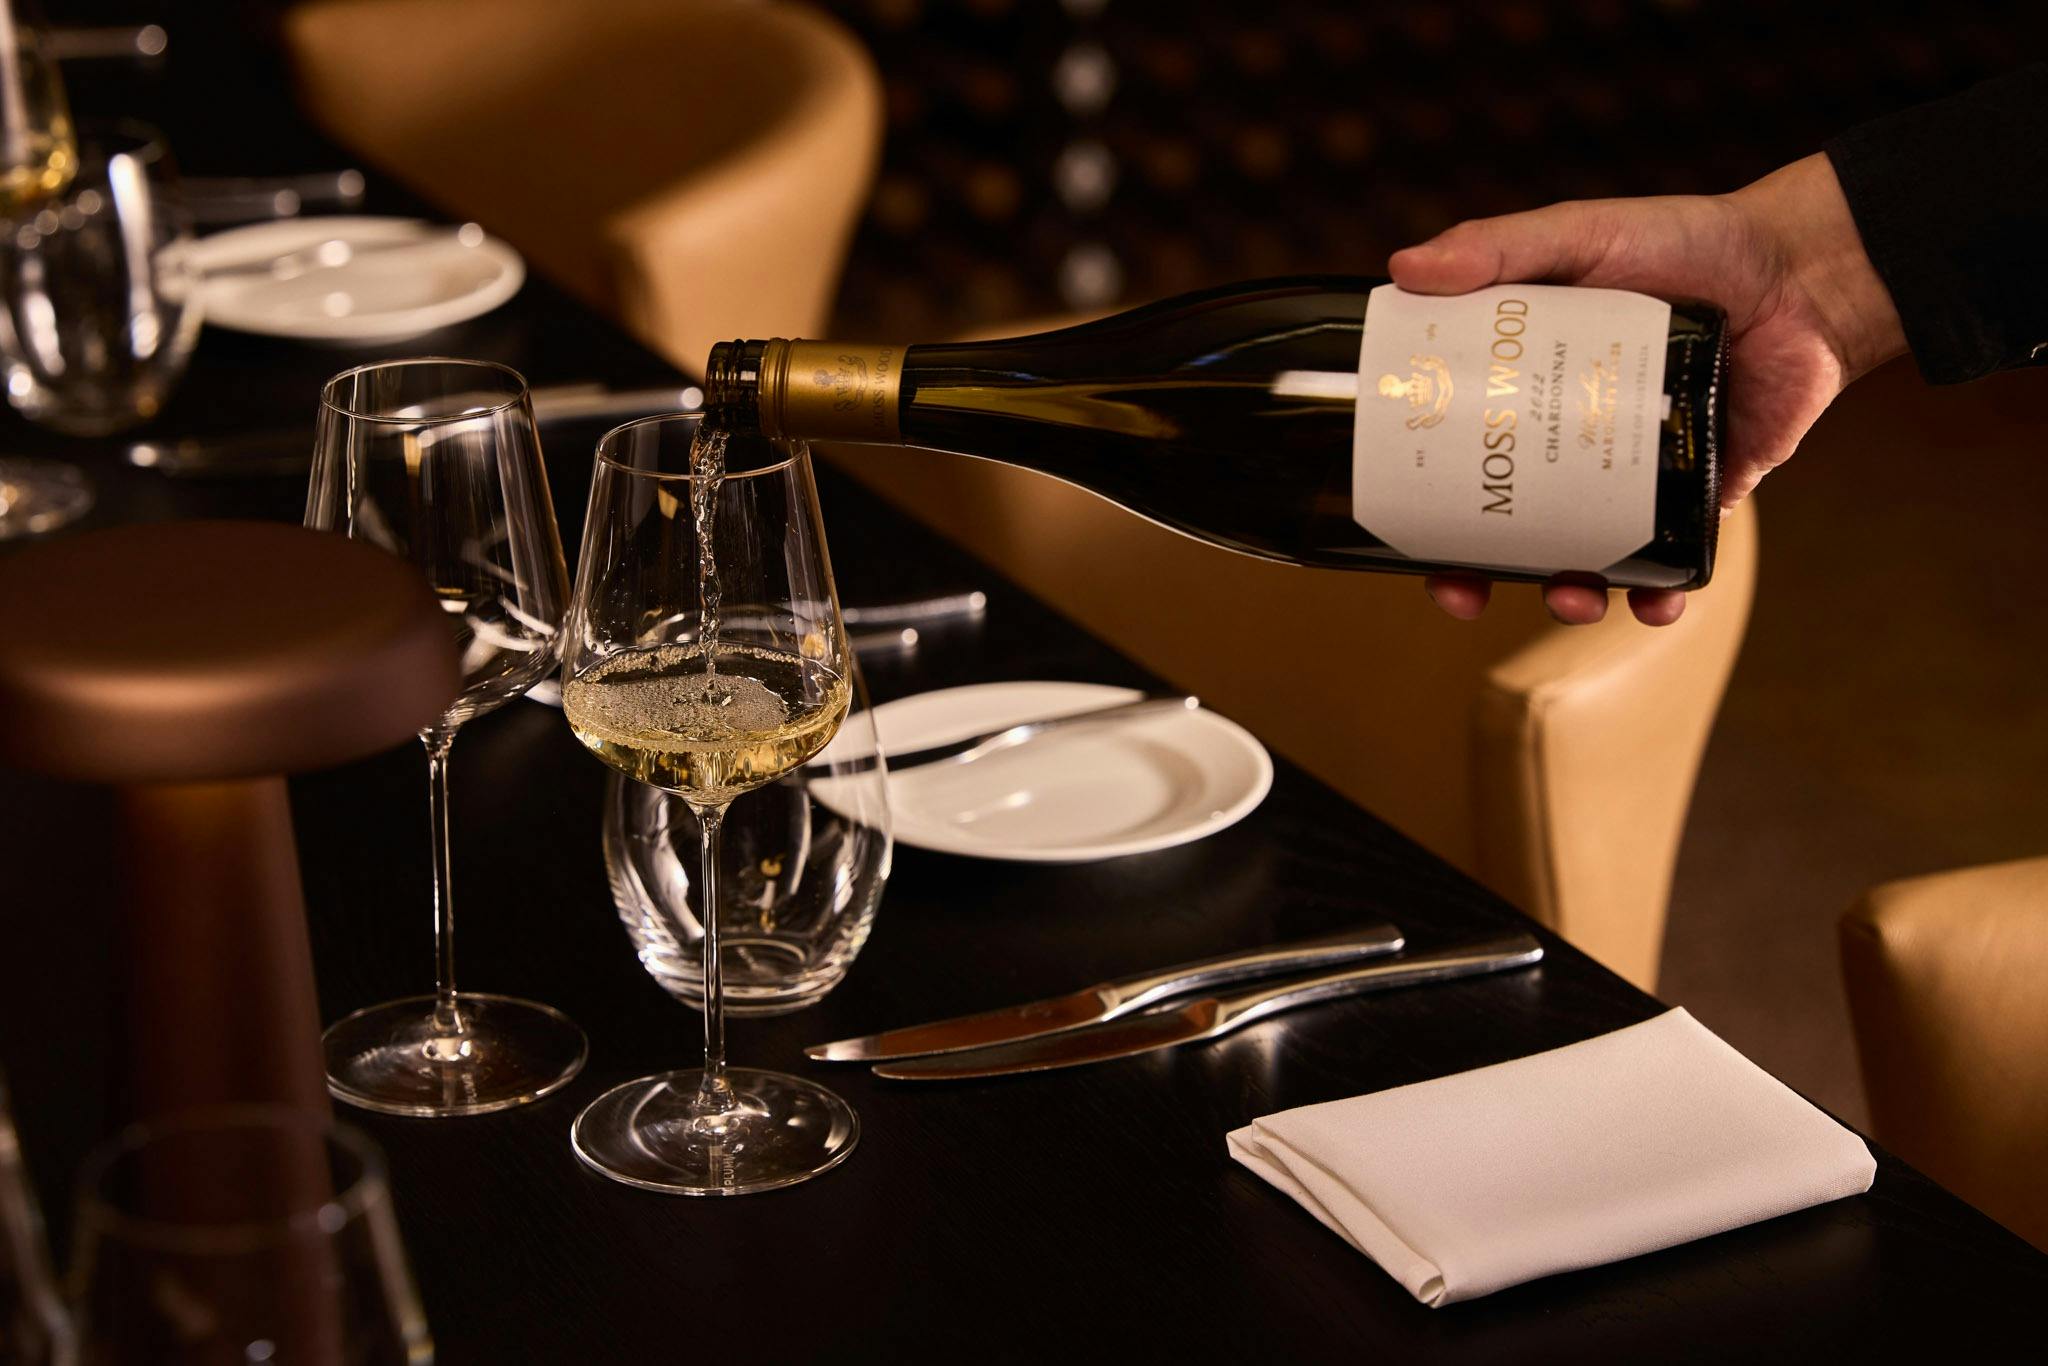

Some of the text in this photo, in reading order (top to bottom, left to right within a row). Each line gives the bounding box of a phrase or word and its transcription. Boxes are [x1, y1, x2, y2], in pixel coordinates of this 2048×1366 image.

[1482, 299, 1528, 516] MOSS WOOD
[1546, 341, 1568, 463] CHARDONNAY
[723, 1153, 736, 1186] PLUMM
